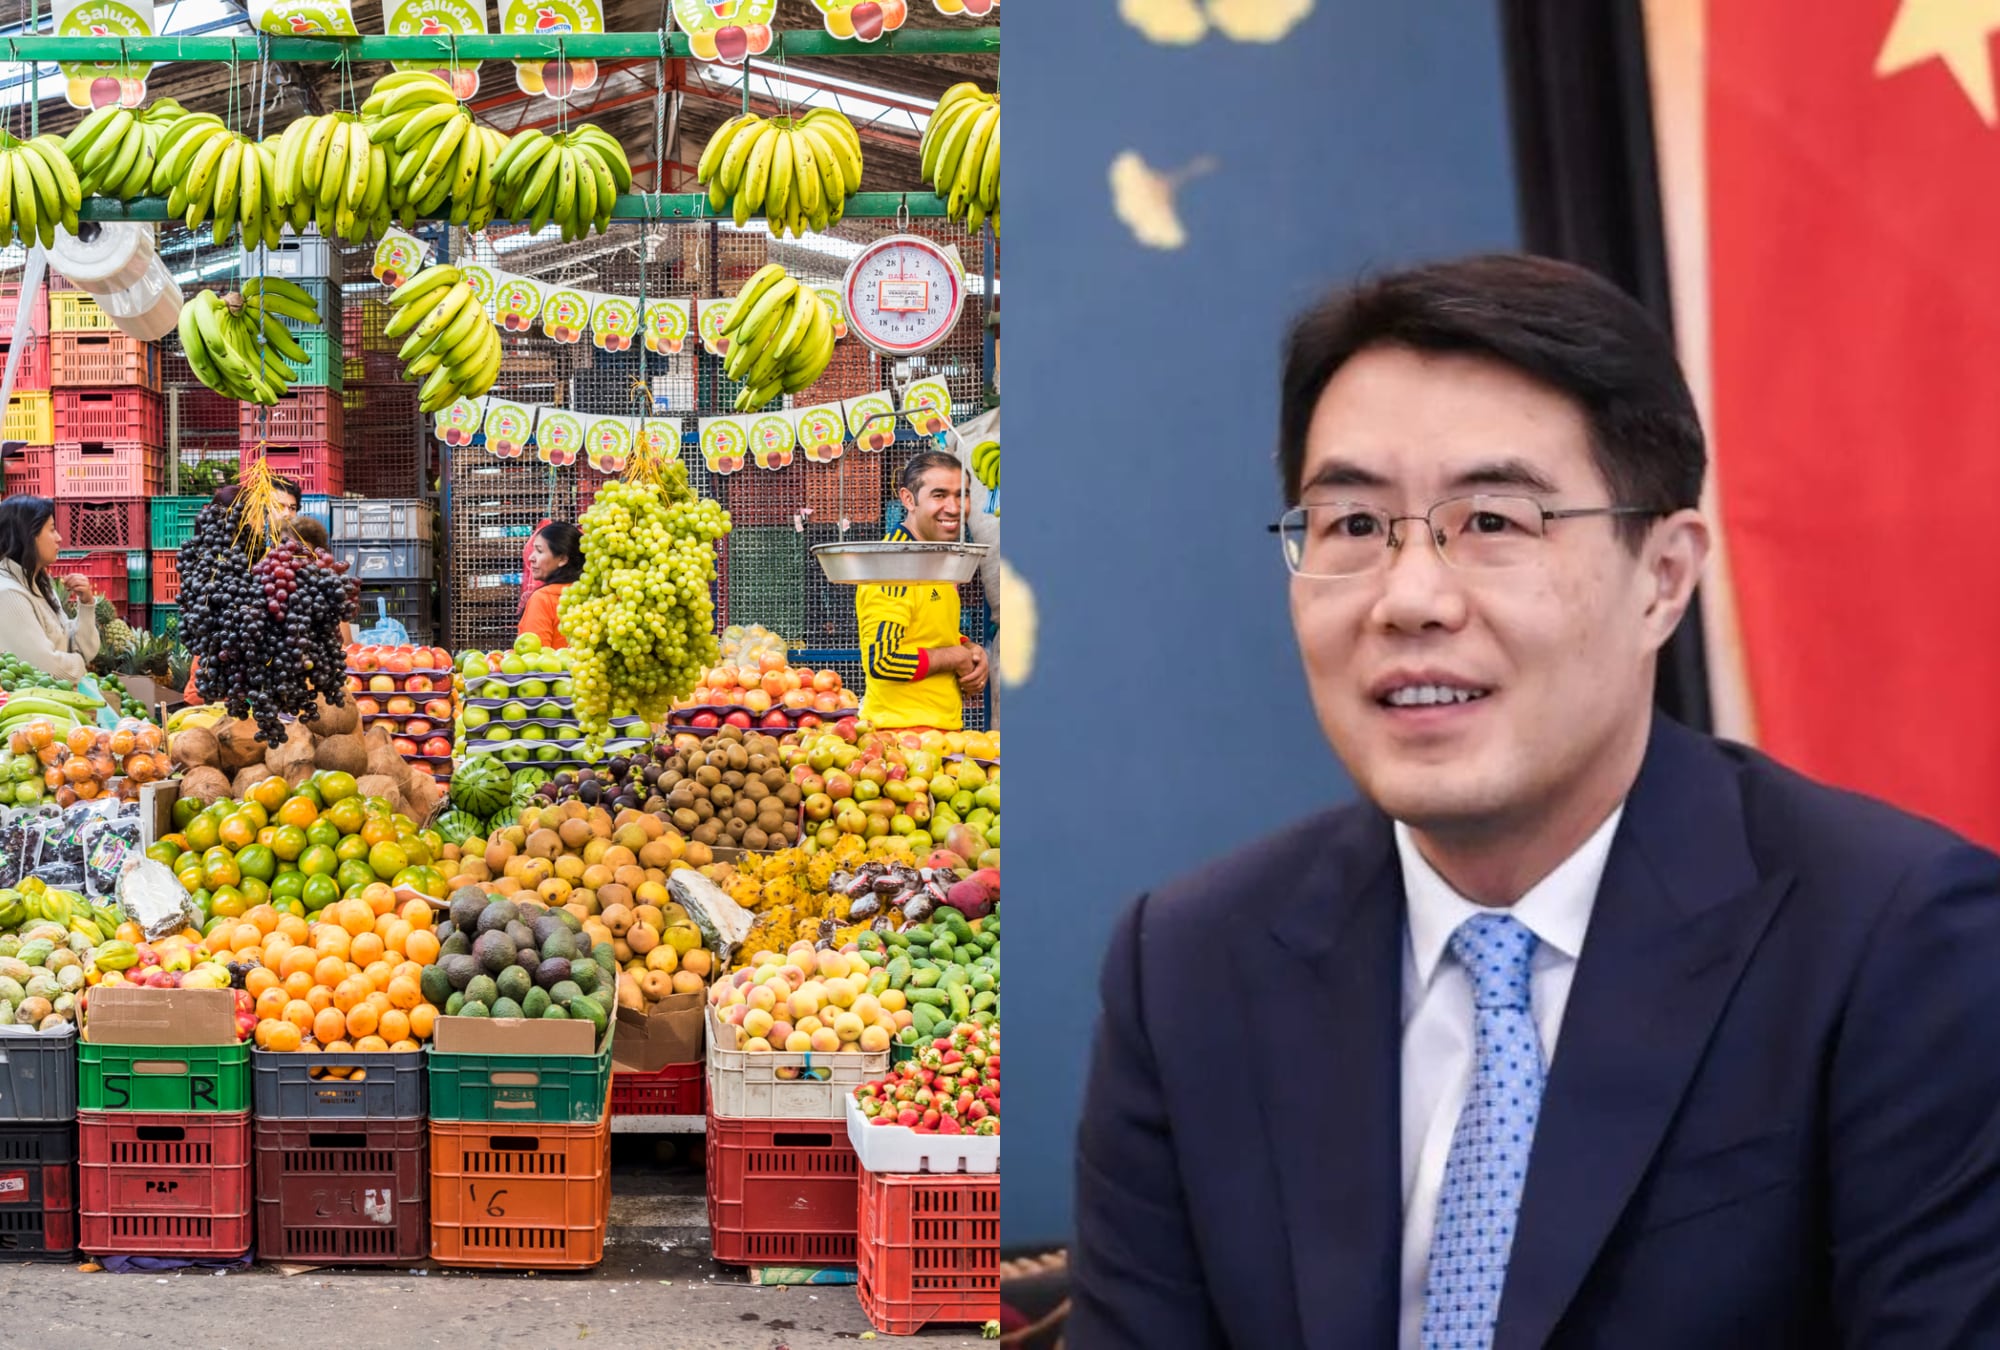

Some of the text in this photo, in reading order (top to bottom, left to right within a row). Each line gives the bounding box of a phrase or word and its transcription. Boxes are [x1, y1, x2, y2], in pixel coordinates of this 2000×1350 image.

[105, 1076, 218, 1109] S R
[146, 1181, 178, 1193] P&P
